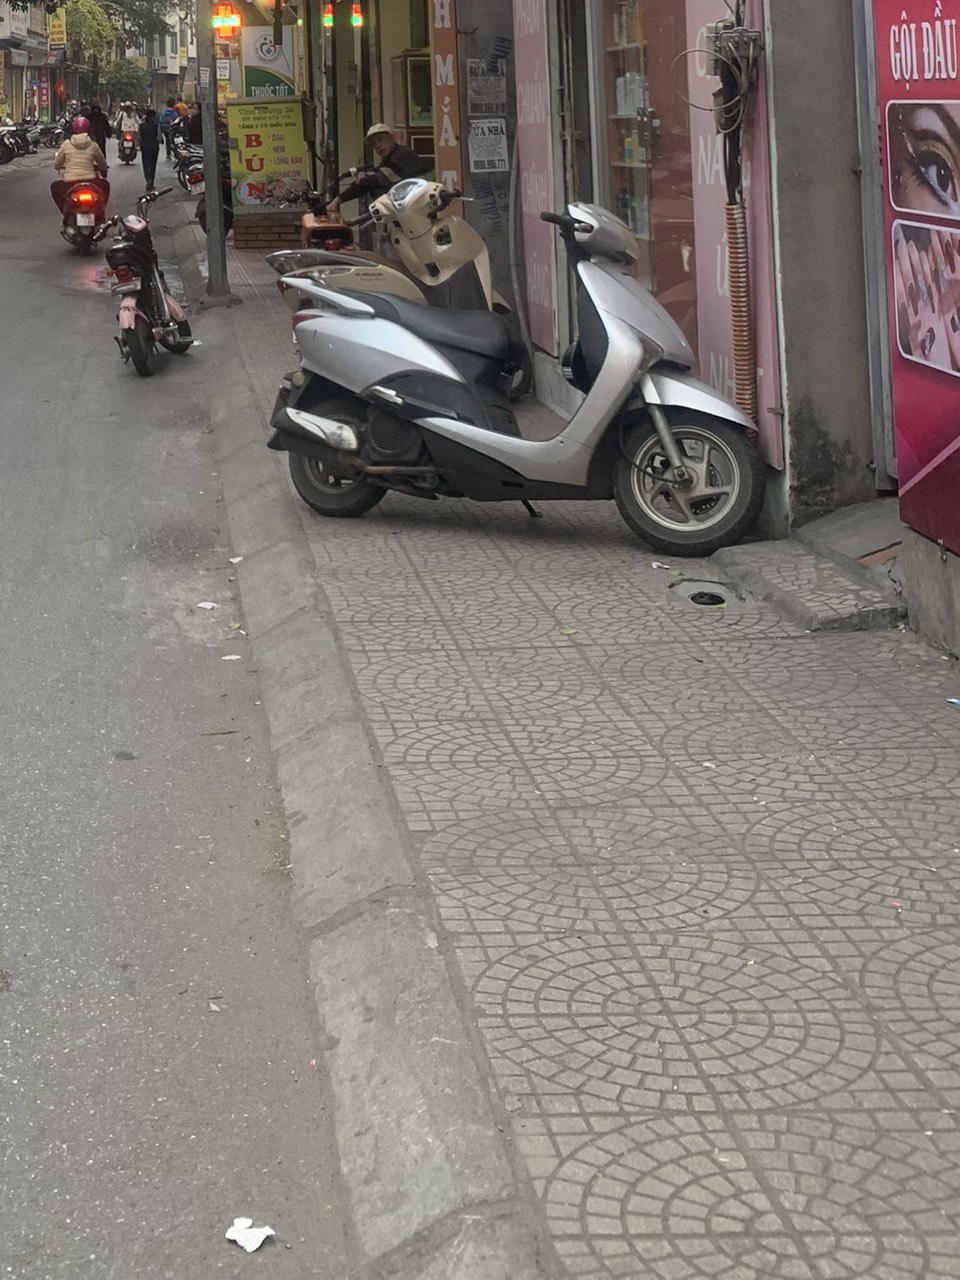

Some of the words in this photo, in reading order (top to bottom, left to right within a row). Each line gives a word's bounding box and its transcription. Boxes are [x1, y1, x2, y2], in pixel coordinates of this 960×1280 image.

[889, 10, 919, 91] GỘI
[921, 0, 958, 81] ĐẦU
[251, 82, 274, 97] THUỐC
[275, 82, 289, 96] TỐT
